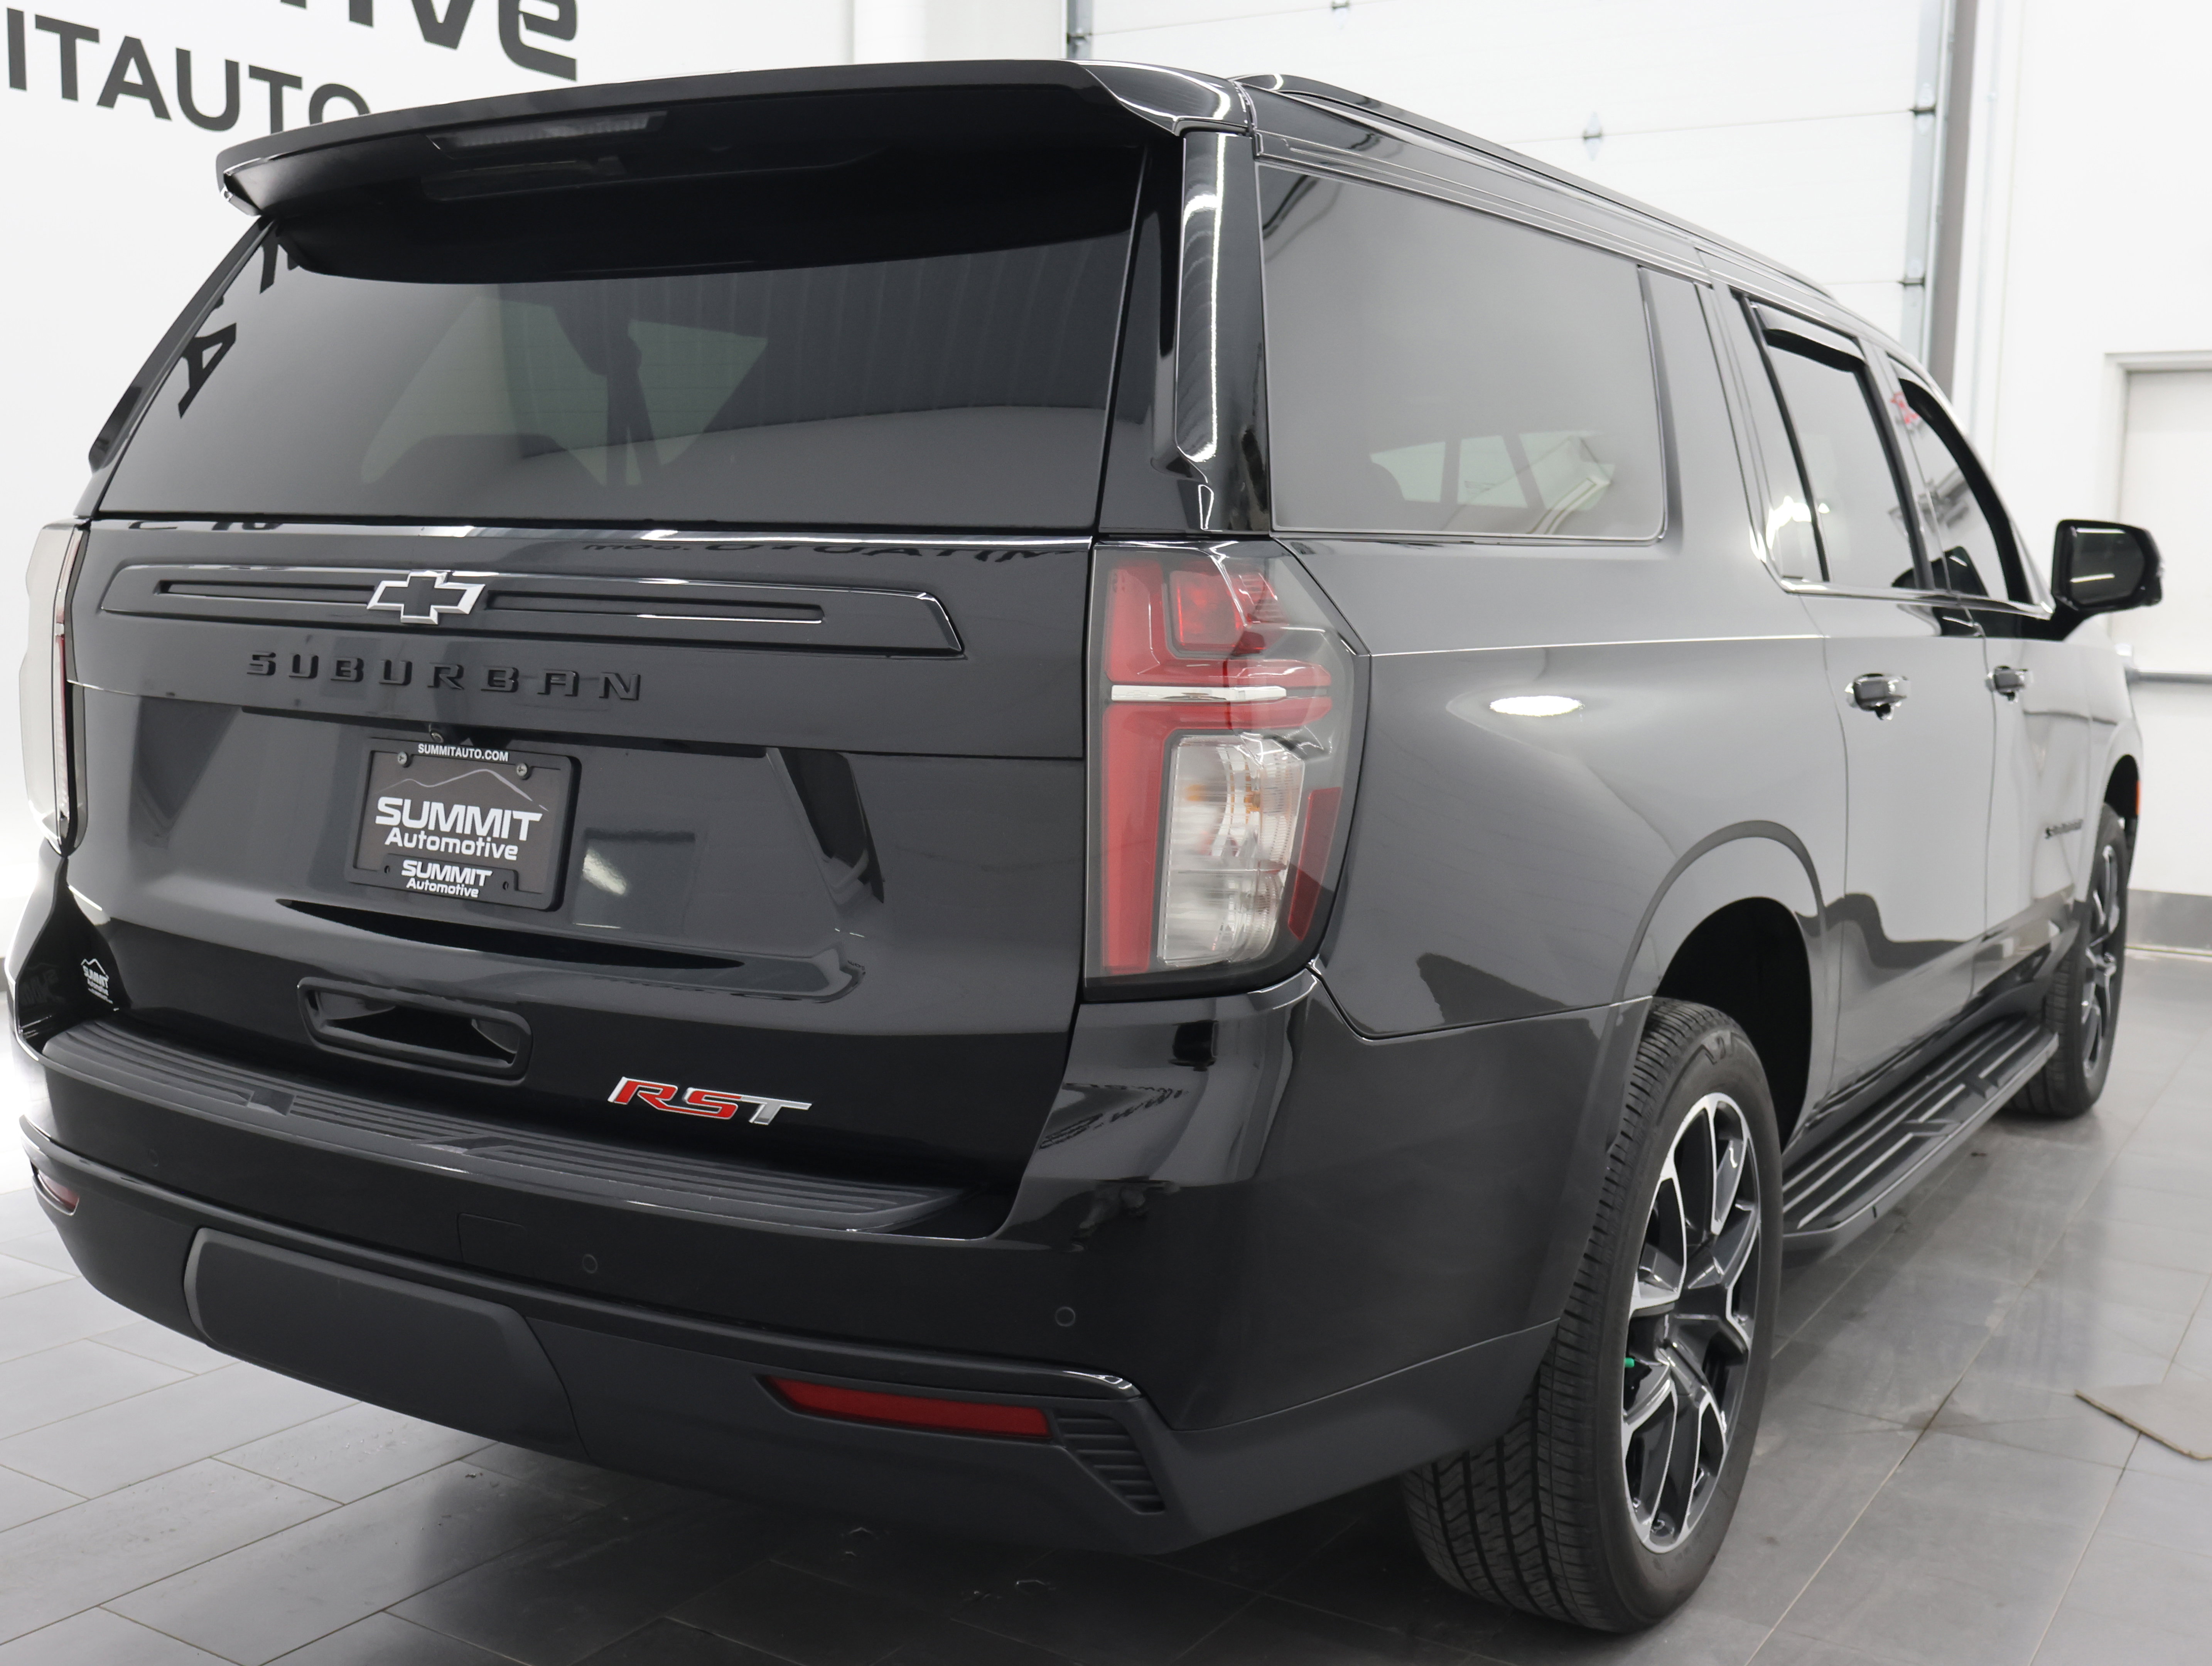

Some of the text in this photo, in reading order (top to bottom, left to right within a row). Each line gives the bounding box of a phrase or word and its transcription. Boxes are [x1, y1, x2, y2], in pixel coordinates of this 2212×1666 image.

[247, 652, 641, 701] SUBURBAN
[418, 743, 509, 762] SUMMITAUTO.COM
[375, 796, 543, 841] SUMMIT
[385, 827, 519, 861] Automotive
[401, 860, 493, 887] SUMMIT
[406, 877, 479, 898] Automotive
[607, 1076, 812, 1125] RST
